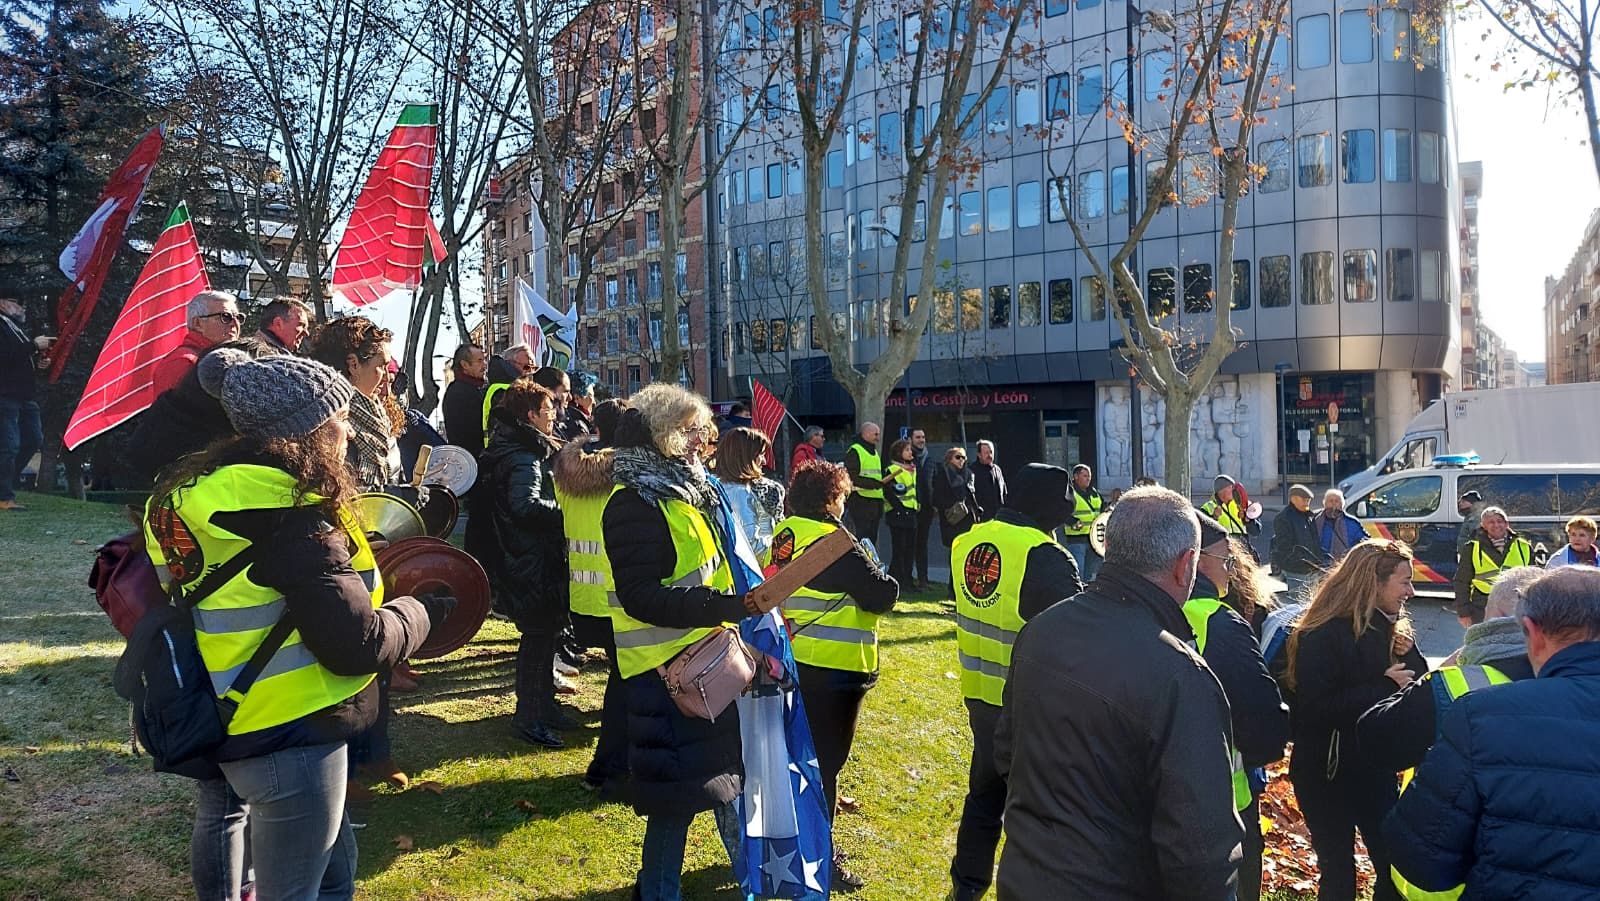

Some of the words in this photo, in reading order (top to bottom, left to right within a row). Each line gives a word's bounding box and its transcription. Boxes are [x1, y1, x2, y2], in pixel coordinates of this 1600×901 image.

[884, 396, 907, 407] unta
[913, 393, 929, 406] de
[982, 395, 990, 408] y
[994, 391, 1029, 404] León
